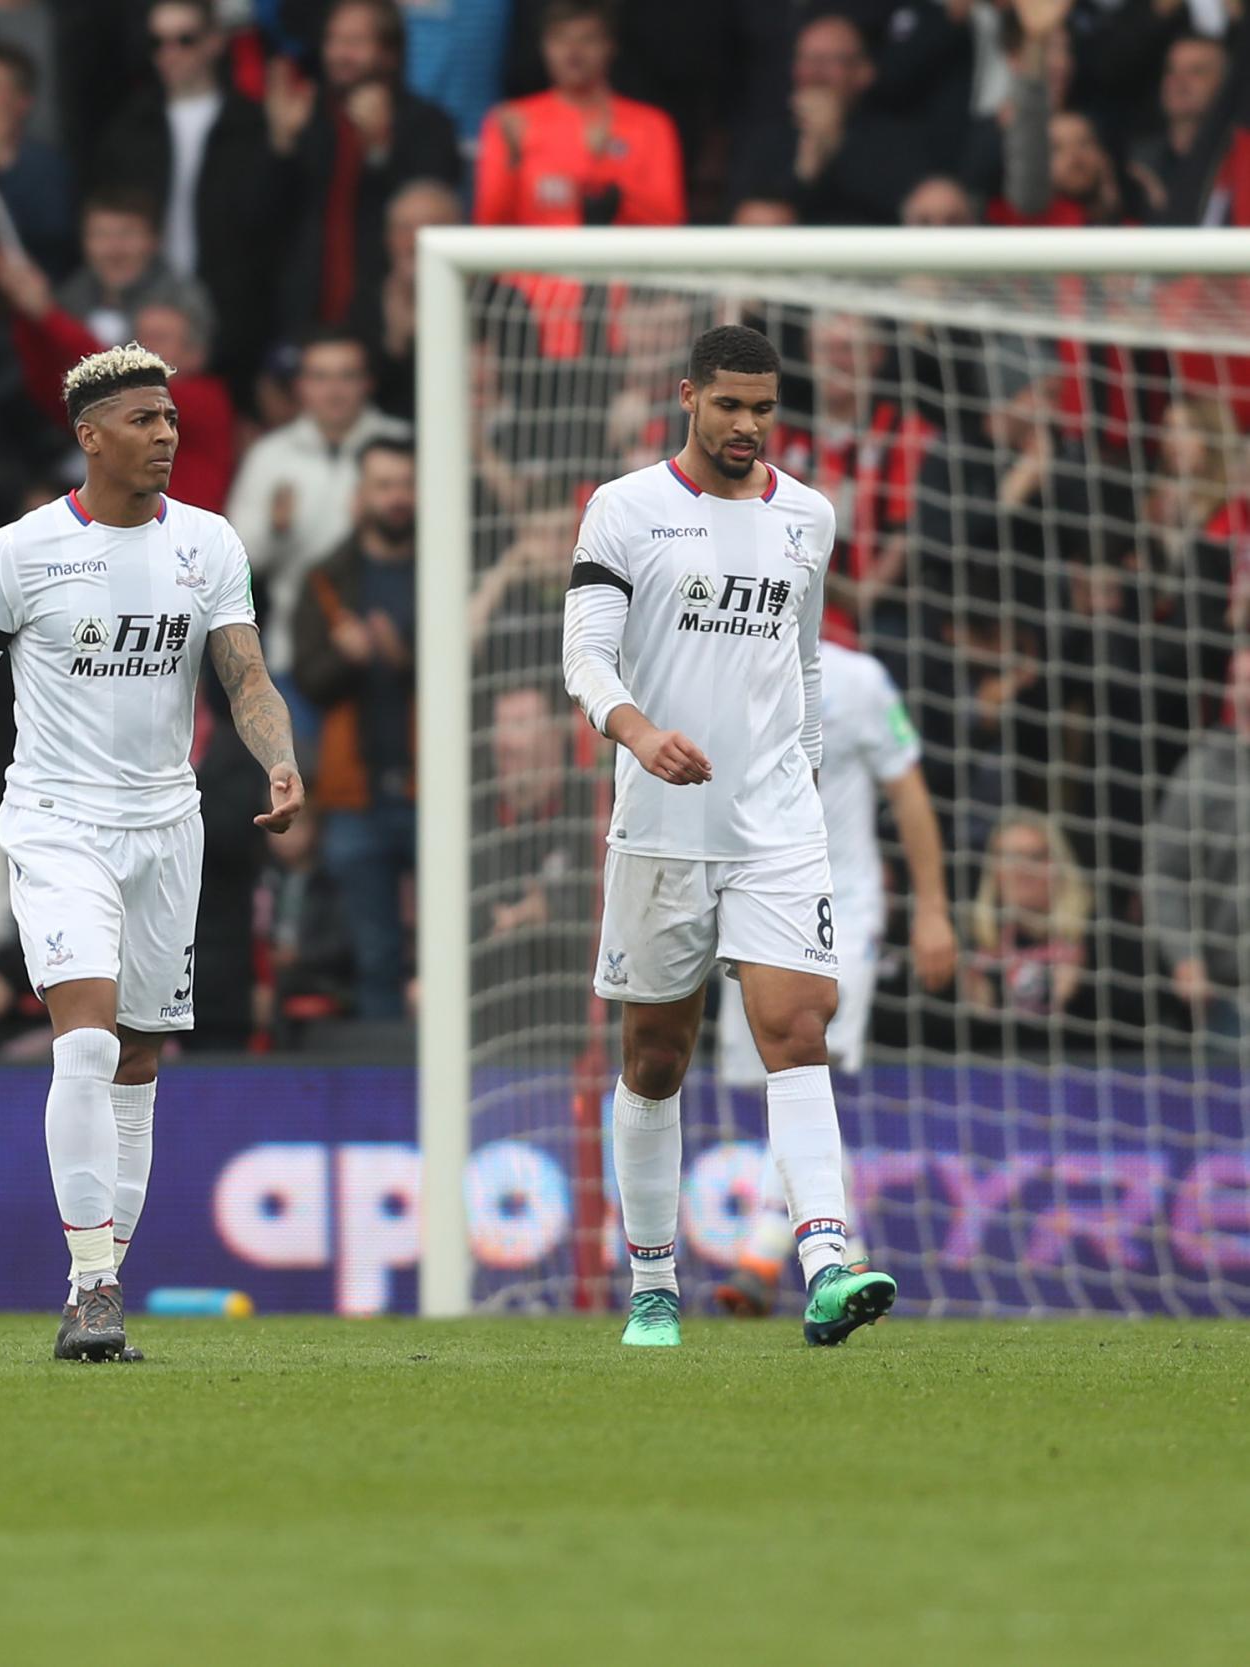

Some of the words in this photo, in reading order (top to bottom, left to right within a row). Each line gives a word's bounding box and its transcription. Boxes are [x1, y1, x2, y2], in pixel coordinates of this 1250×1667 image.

[651, 527, 708, 540] macron
[47, 560, 107, 577] macron
[718, 574, 791, 617] 万博
[112, 613, 191, 653] 万博
[678, 612, 783, 641] ManBetX
[70, 655, 183, 678] ManBetX
[817, 897, 834, 950] 8
